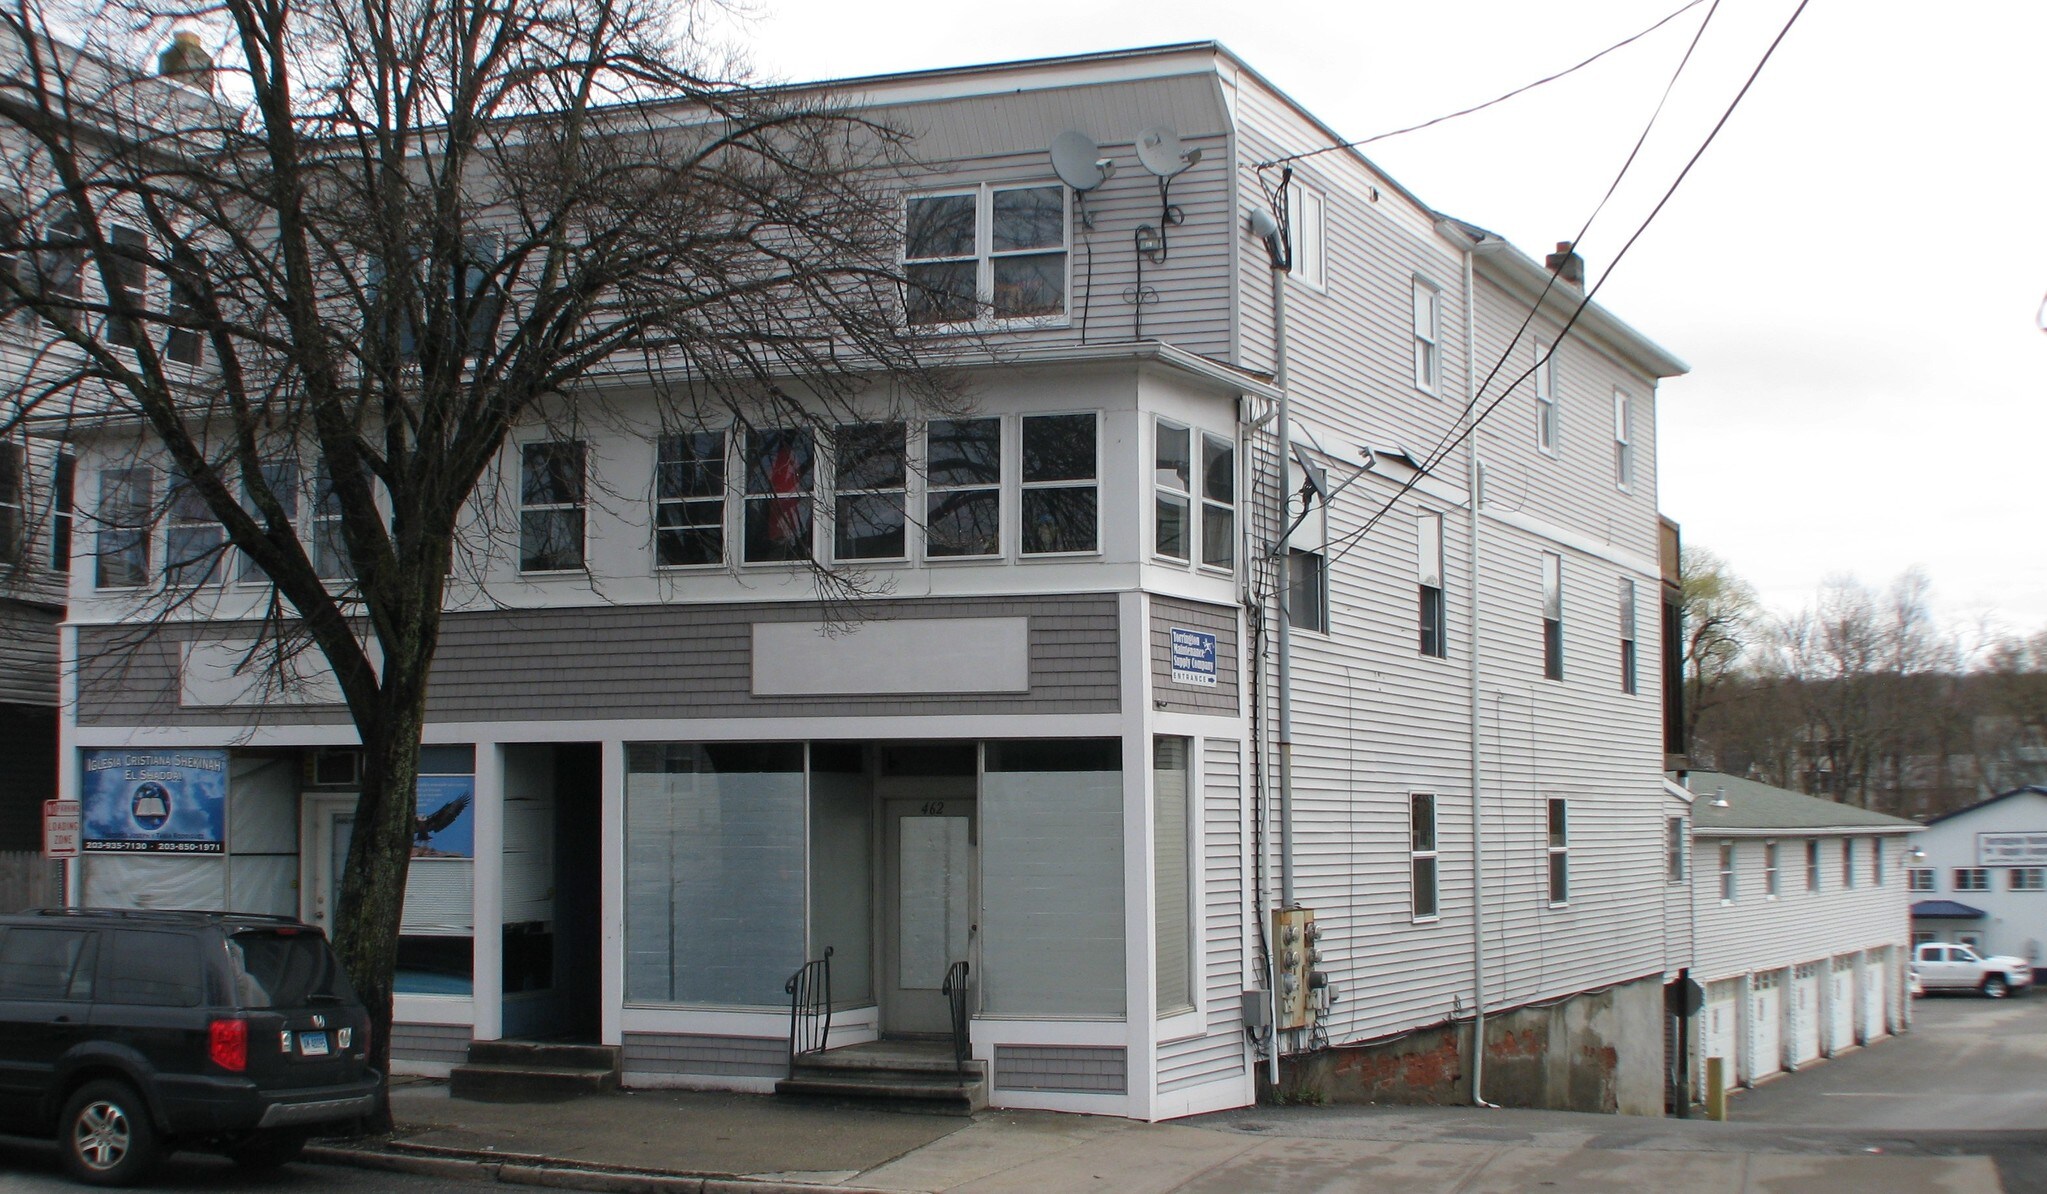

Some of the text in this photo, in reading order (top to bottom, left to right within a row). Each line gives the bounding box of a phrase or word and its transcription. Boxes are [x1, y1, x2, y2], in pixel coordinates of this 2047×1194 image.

[1173, 631, 1200, 646] Torrington
[1173, 643, 1205, 658] Maintenance
[1174, 655, 1214, 672] Supply Company
[1173, 672, 1206, 683] ENTRANCE
[920, 801, 944, 815] 462
[48, 822, 80, 831] LOADING
[54, 835, 73, 844] ZONE
[86, 841, 221, 852] 203-935-7130 203-850-1971
